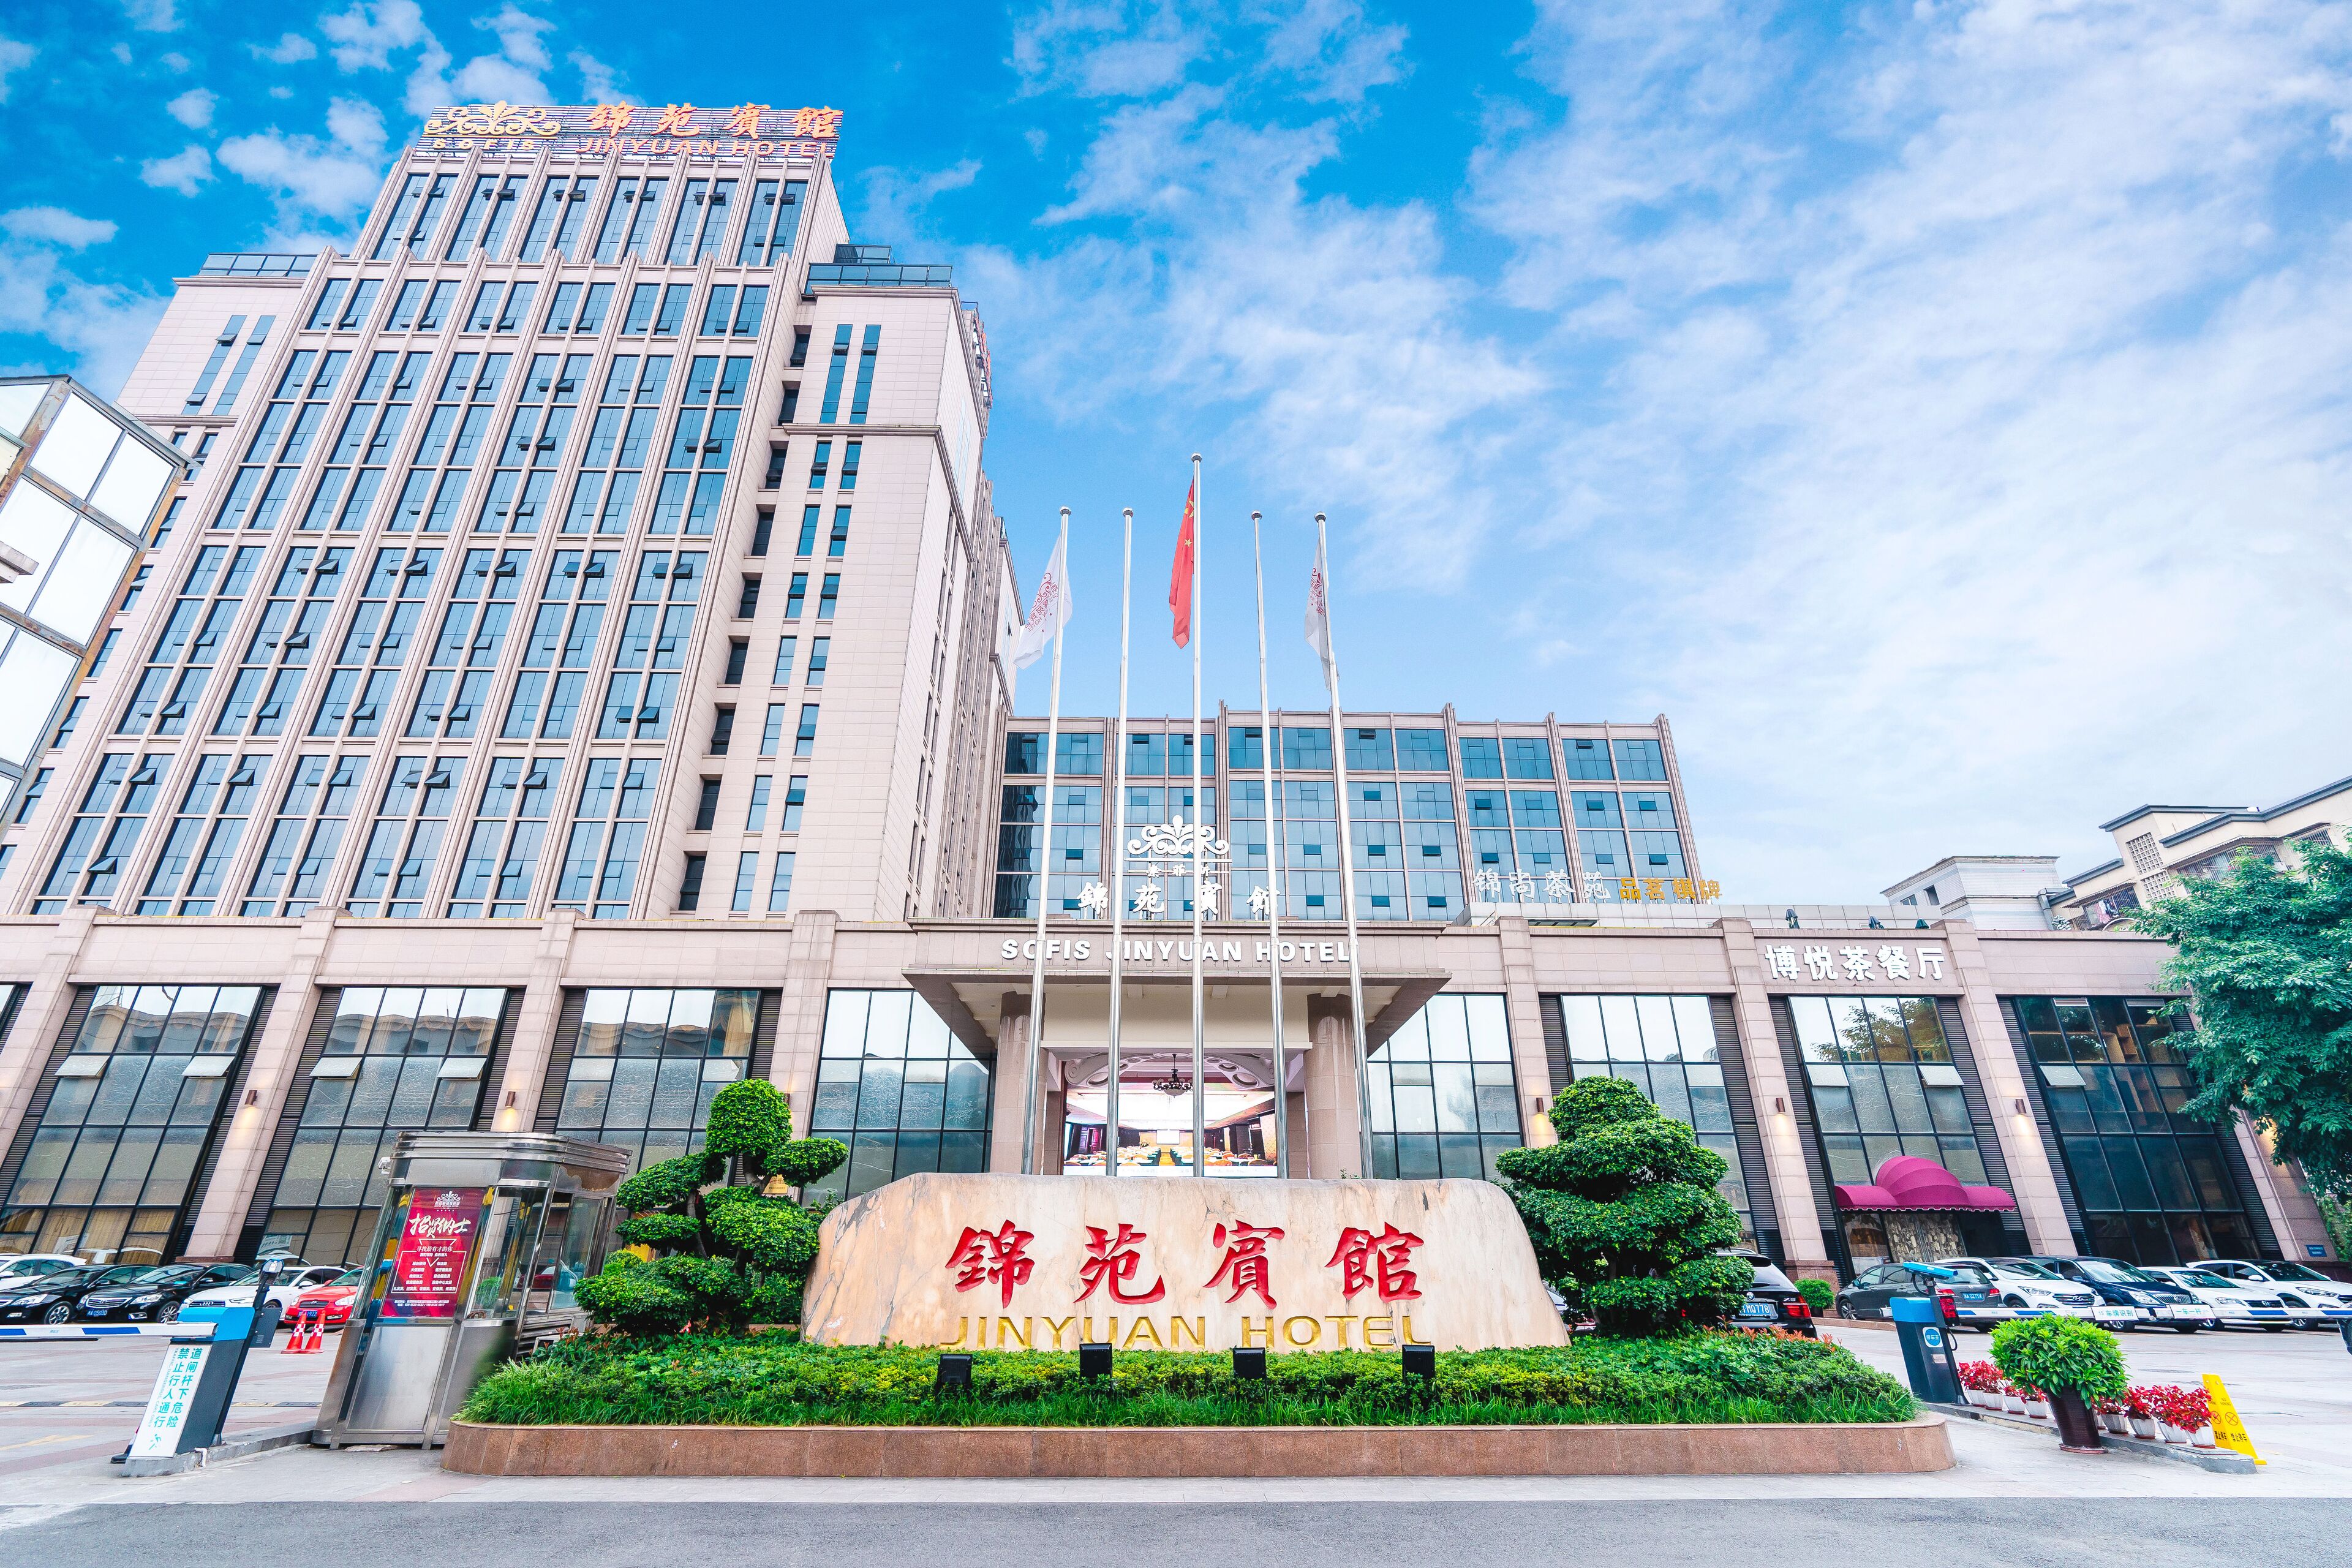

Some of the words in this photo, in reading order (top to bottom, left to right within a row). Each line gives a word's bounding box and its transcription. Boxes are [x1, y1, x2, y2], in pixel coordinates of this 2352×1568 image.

[586, 101, 843, 139] 錦苑賓館
[432, 138, 535, 151] SOFIS
[575, 139, 717, 154] JINYUAN
[732, 141, 834, 157] HOTEL
[1472, 868, 1611, 900] 锦尚茶苑
[1619, 878, 1722, 900] 品茗棋牌
[1001, 939, 1091, 960] SOFIS
[1256, 941, 1349, 962] HOTEL
[1765, 944, 1945, 981] 博悦茶餐厅
[409, 1213, 472, 1238] 招贤纳士
[944, 1219, 1424, 1310] 錦苑賓館
[940, 1316, 1205, 1349] JINYUAN
[1242, 1316, 1431, 1348] HOTEL
[154, 1348, 190, 1428] 禁止行人通行
[166, 1348, 203, 1427] 道闸杆下危险
